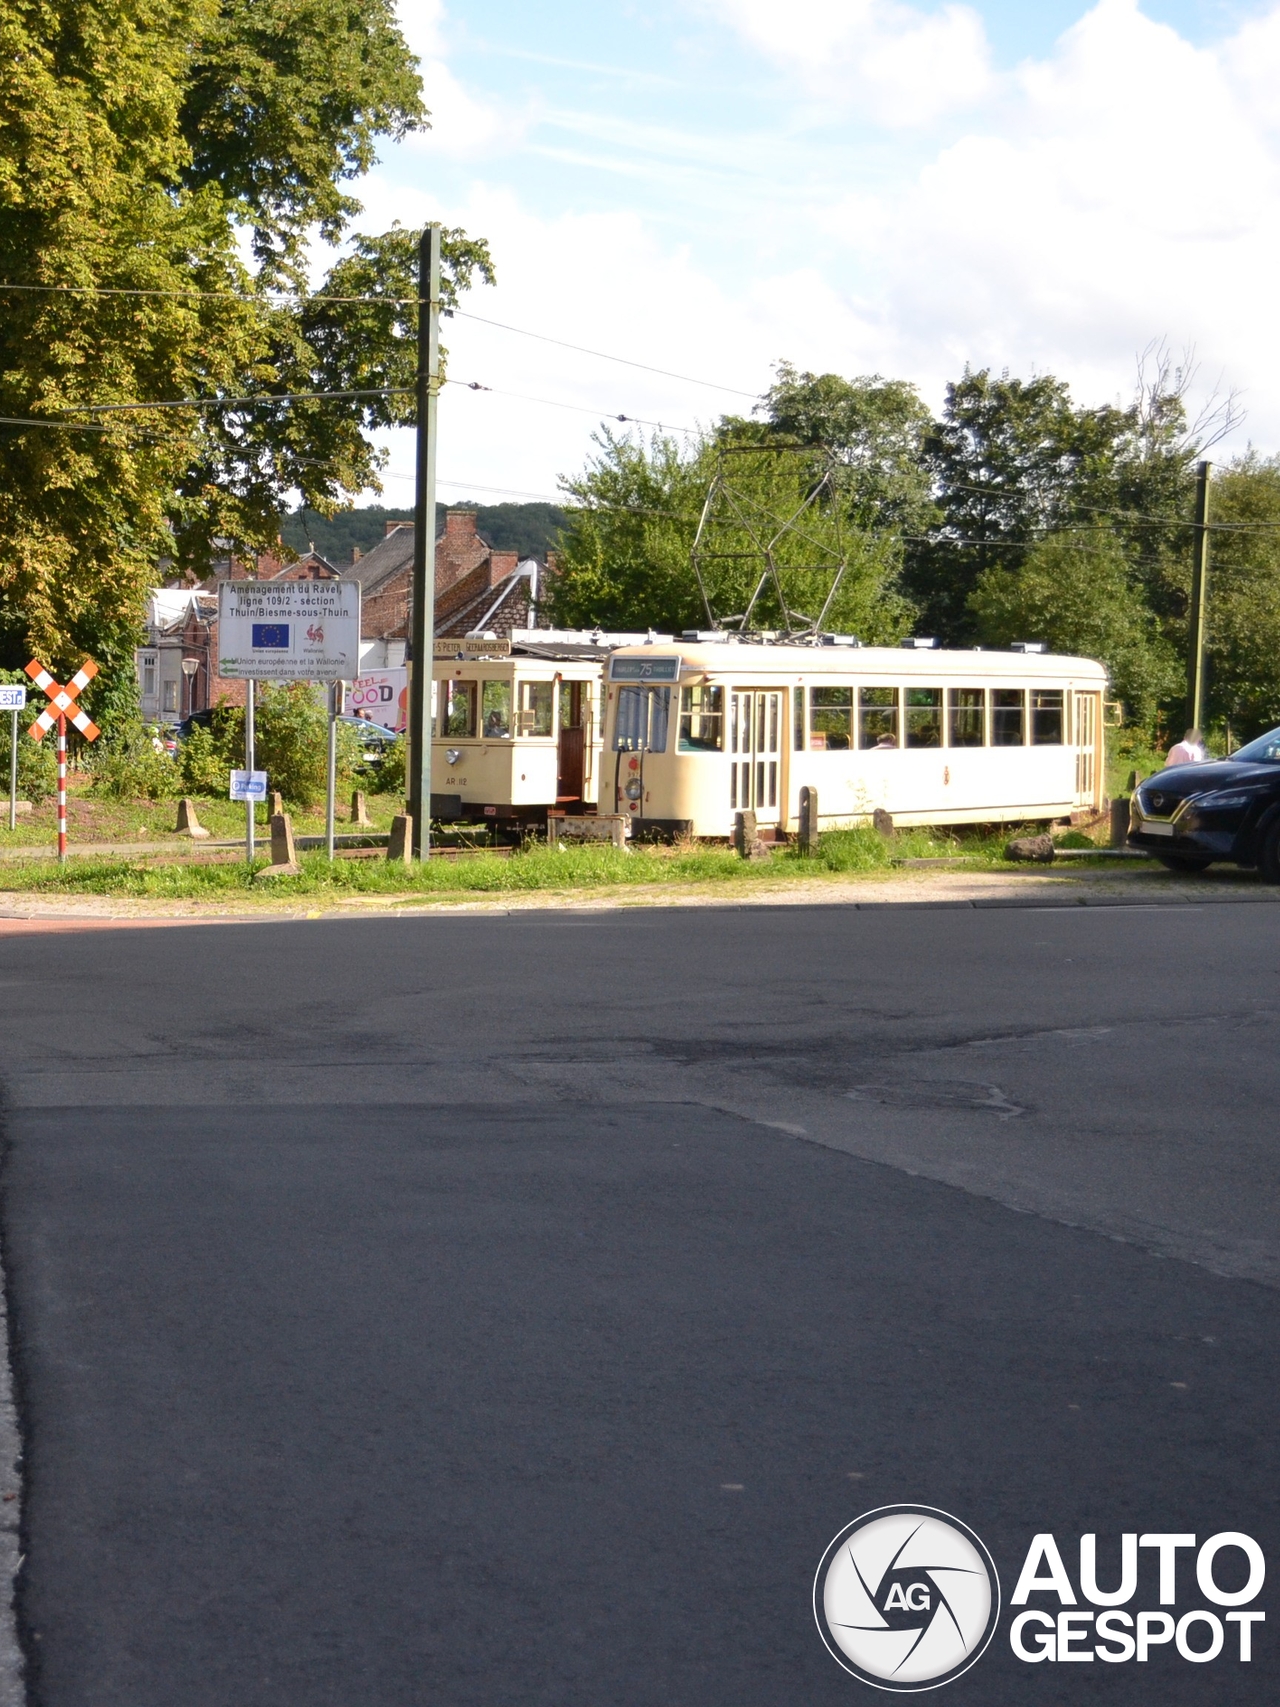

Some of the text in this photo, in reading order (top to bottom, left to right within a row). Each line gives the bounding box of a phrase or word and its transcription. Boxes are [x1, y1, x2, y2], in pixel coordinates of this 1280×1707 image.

[230, 584, 342, 596] Aménagement du Ravel,
[240, 596, 263, 607] ligne
[266, 596, 291, 605] 109/2
[300, 596, 335, 605] section
[229, 607, 349, 617] Thuin/Biesme-sous-Thuin
[258, 657, 298, 667] européenne
[307, 657, 314, 665] la
[315, 657, 345, 665] Wallonie
[279, 667, 295, 675] dans
[640, 663, 652, 675] 75
